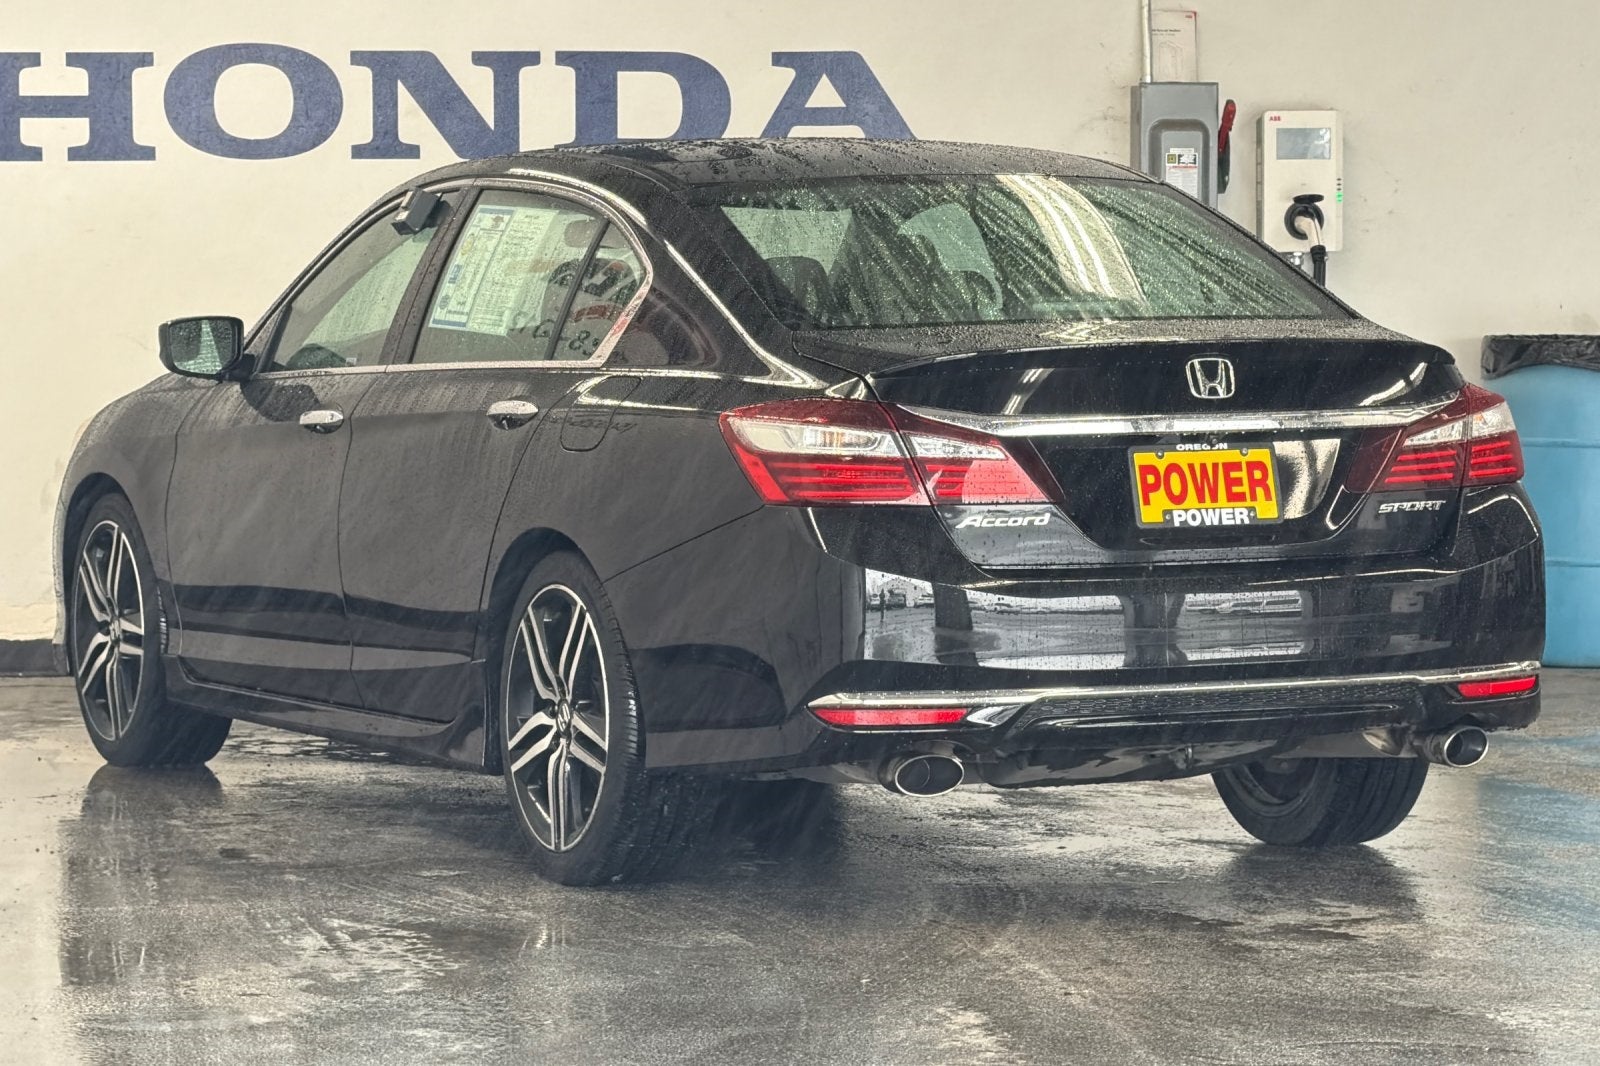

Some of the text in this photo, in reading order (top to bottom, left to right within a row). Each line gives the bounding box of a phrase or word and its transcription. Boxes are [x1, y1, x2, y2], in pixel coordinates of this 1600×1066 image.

[0, 43, 919, 161] HONDA
[1138, 460, 1273, 506] POWER
[1378, 500, 1447, 514] SPORT
[954, 512, 1051, 529] Accord
[1172, 508, 1250, 527] POWER
